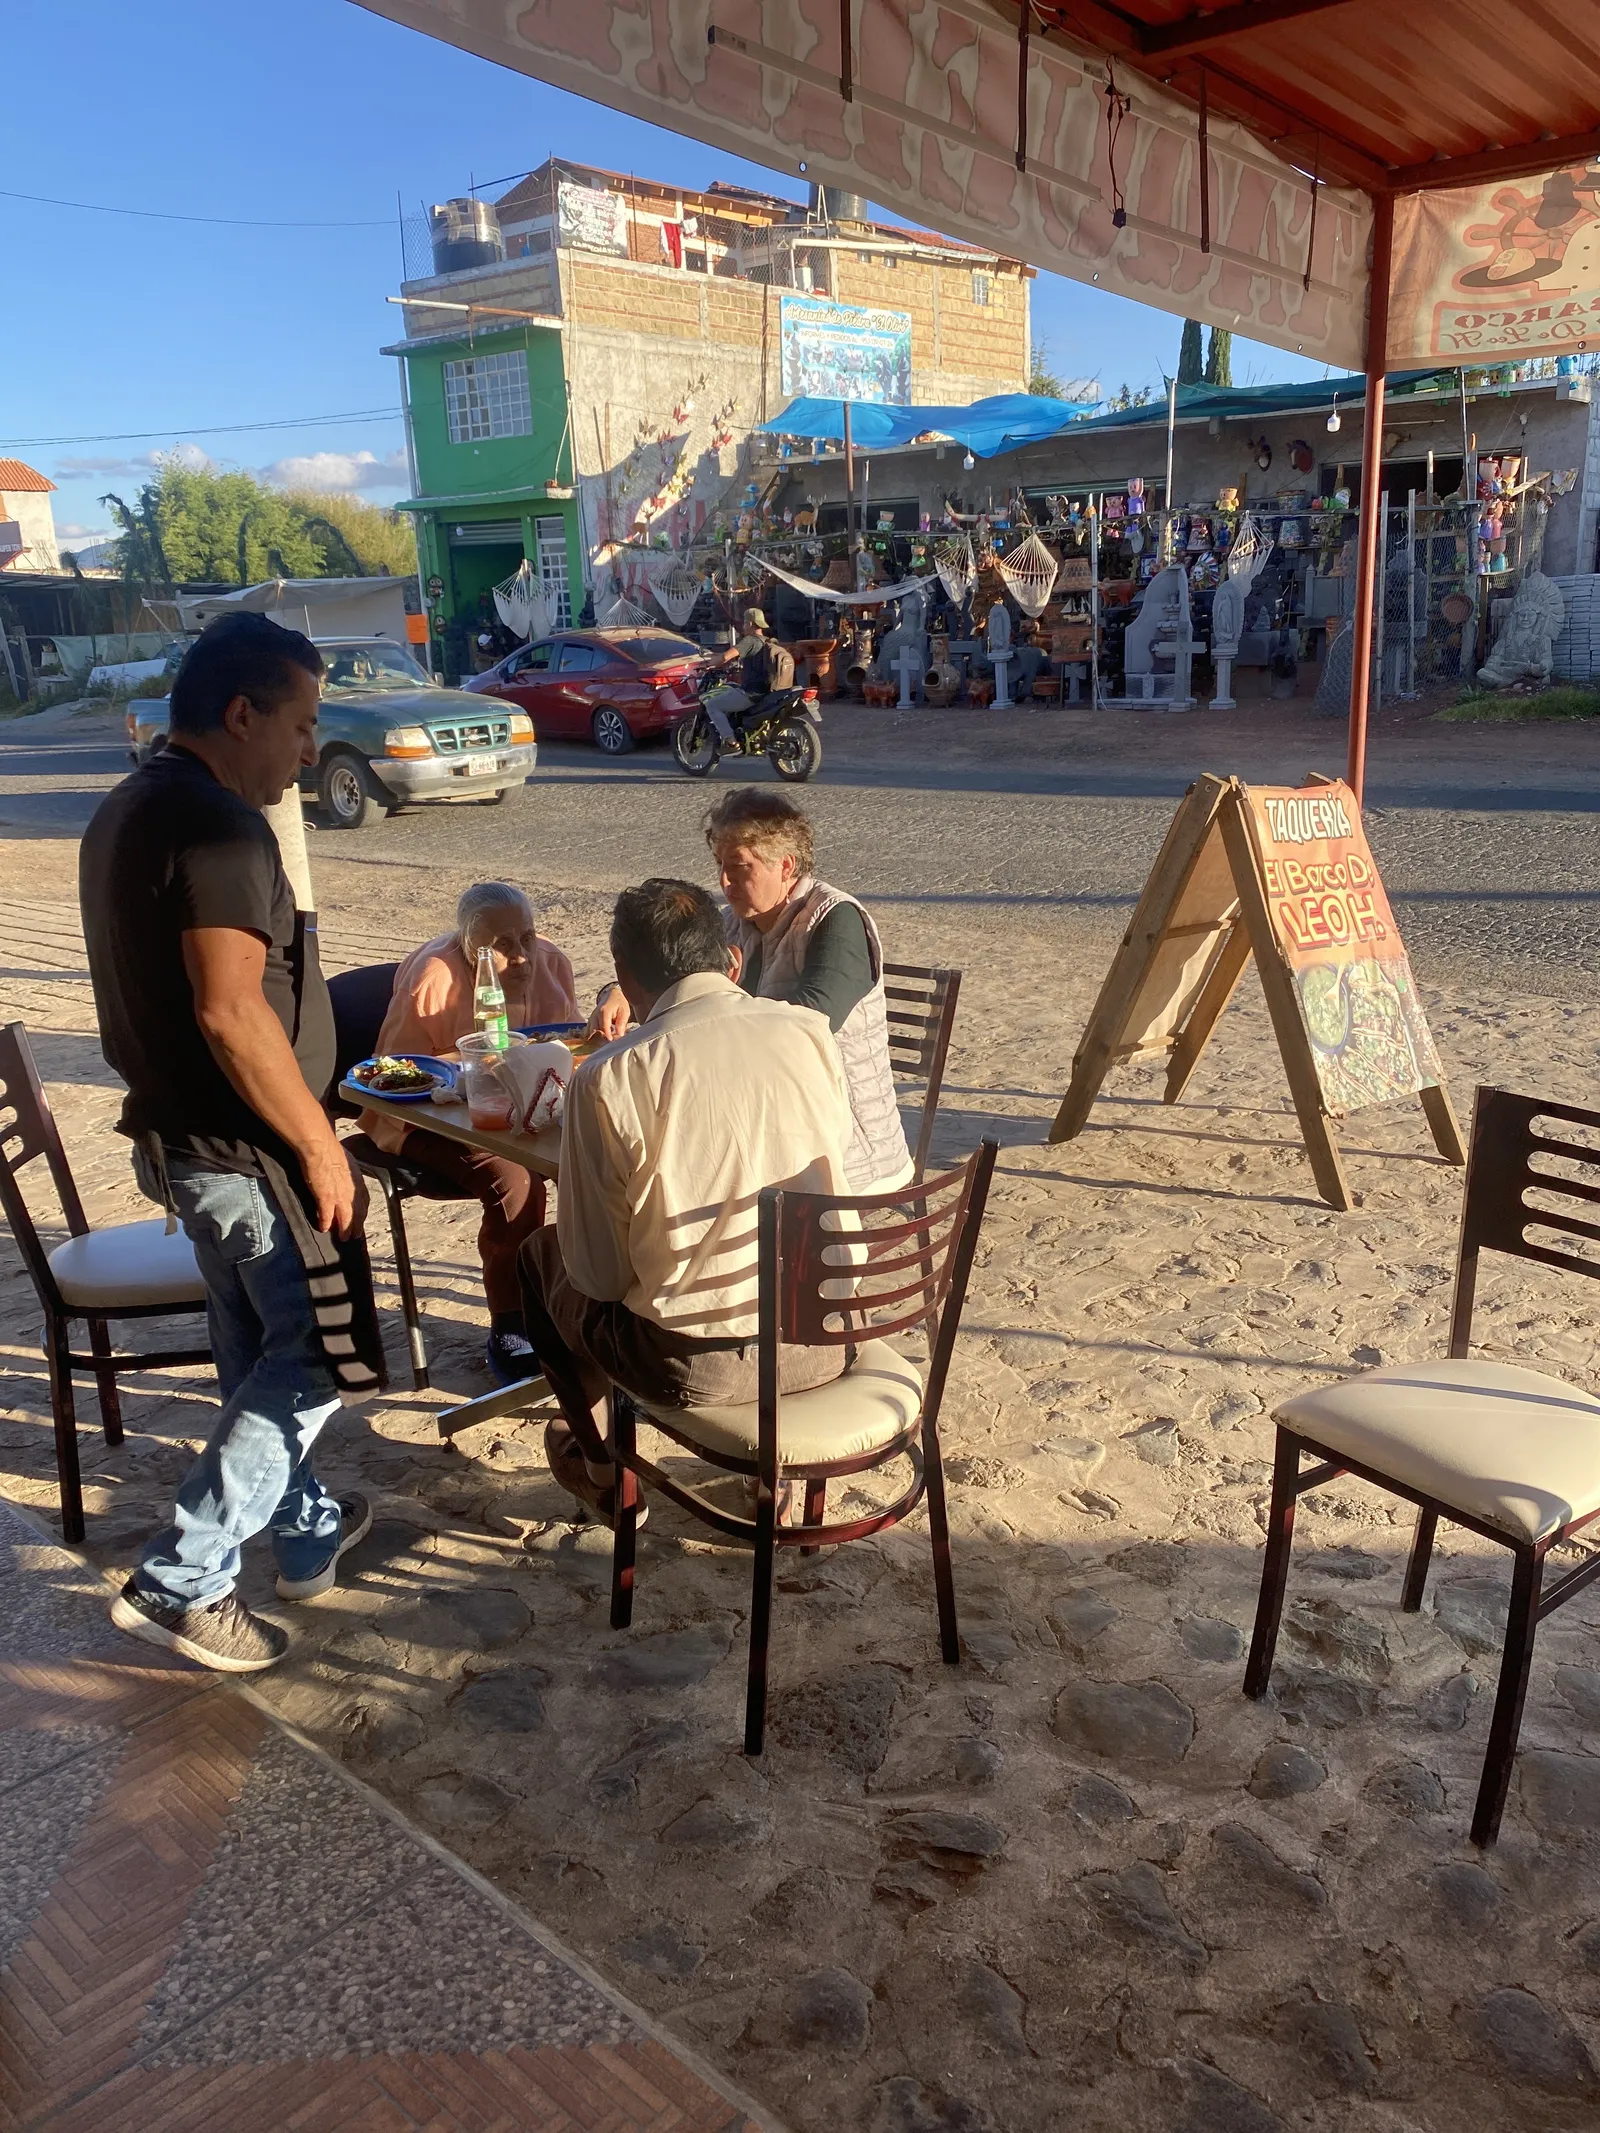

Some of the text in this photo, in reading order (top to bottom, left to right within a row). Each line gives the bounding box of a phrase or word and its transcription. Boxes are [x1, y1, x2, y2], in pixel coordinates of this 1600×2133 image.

[843, 310, 871, 328] Piedra
[801, 330, 825, 339] INFORMES
[831, 333, 851, 342] PEDIDOS
[1264, 859, 1285, 897] El
[1283, 858, 1347, 894] Barco
[1279, 891, 1387, 951] LEO H.
